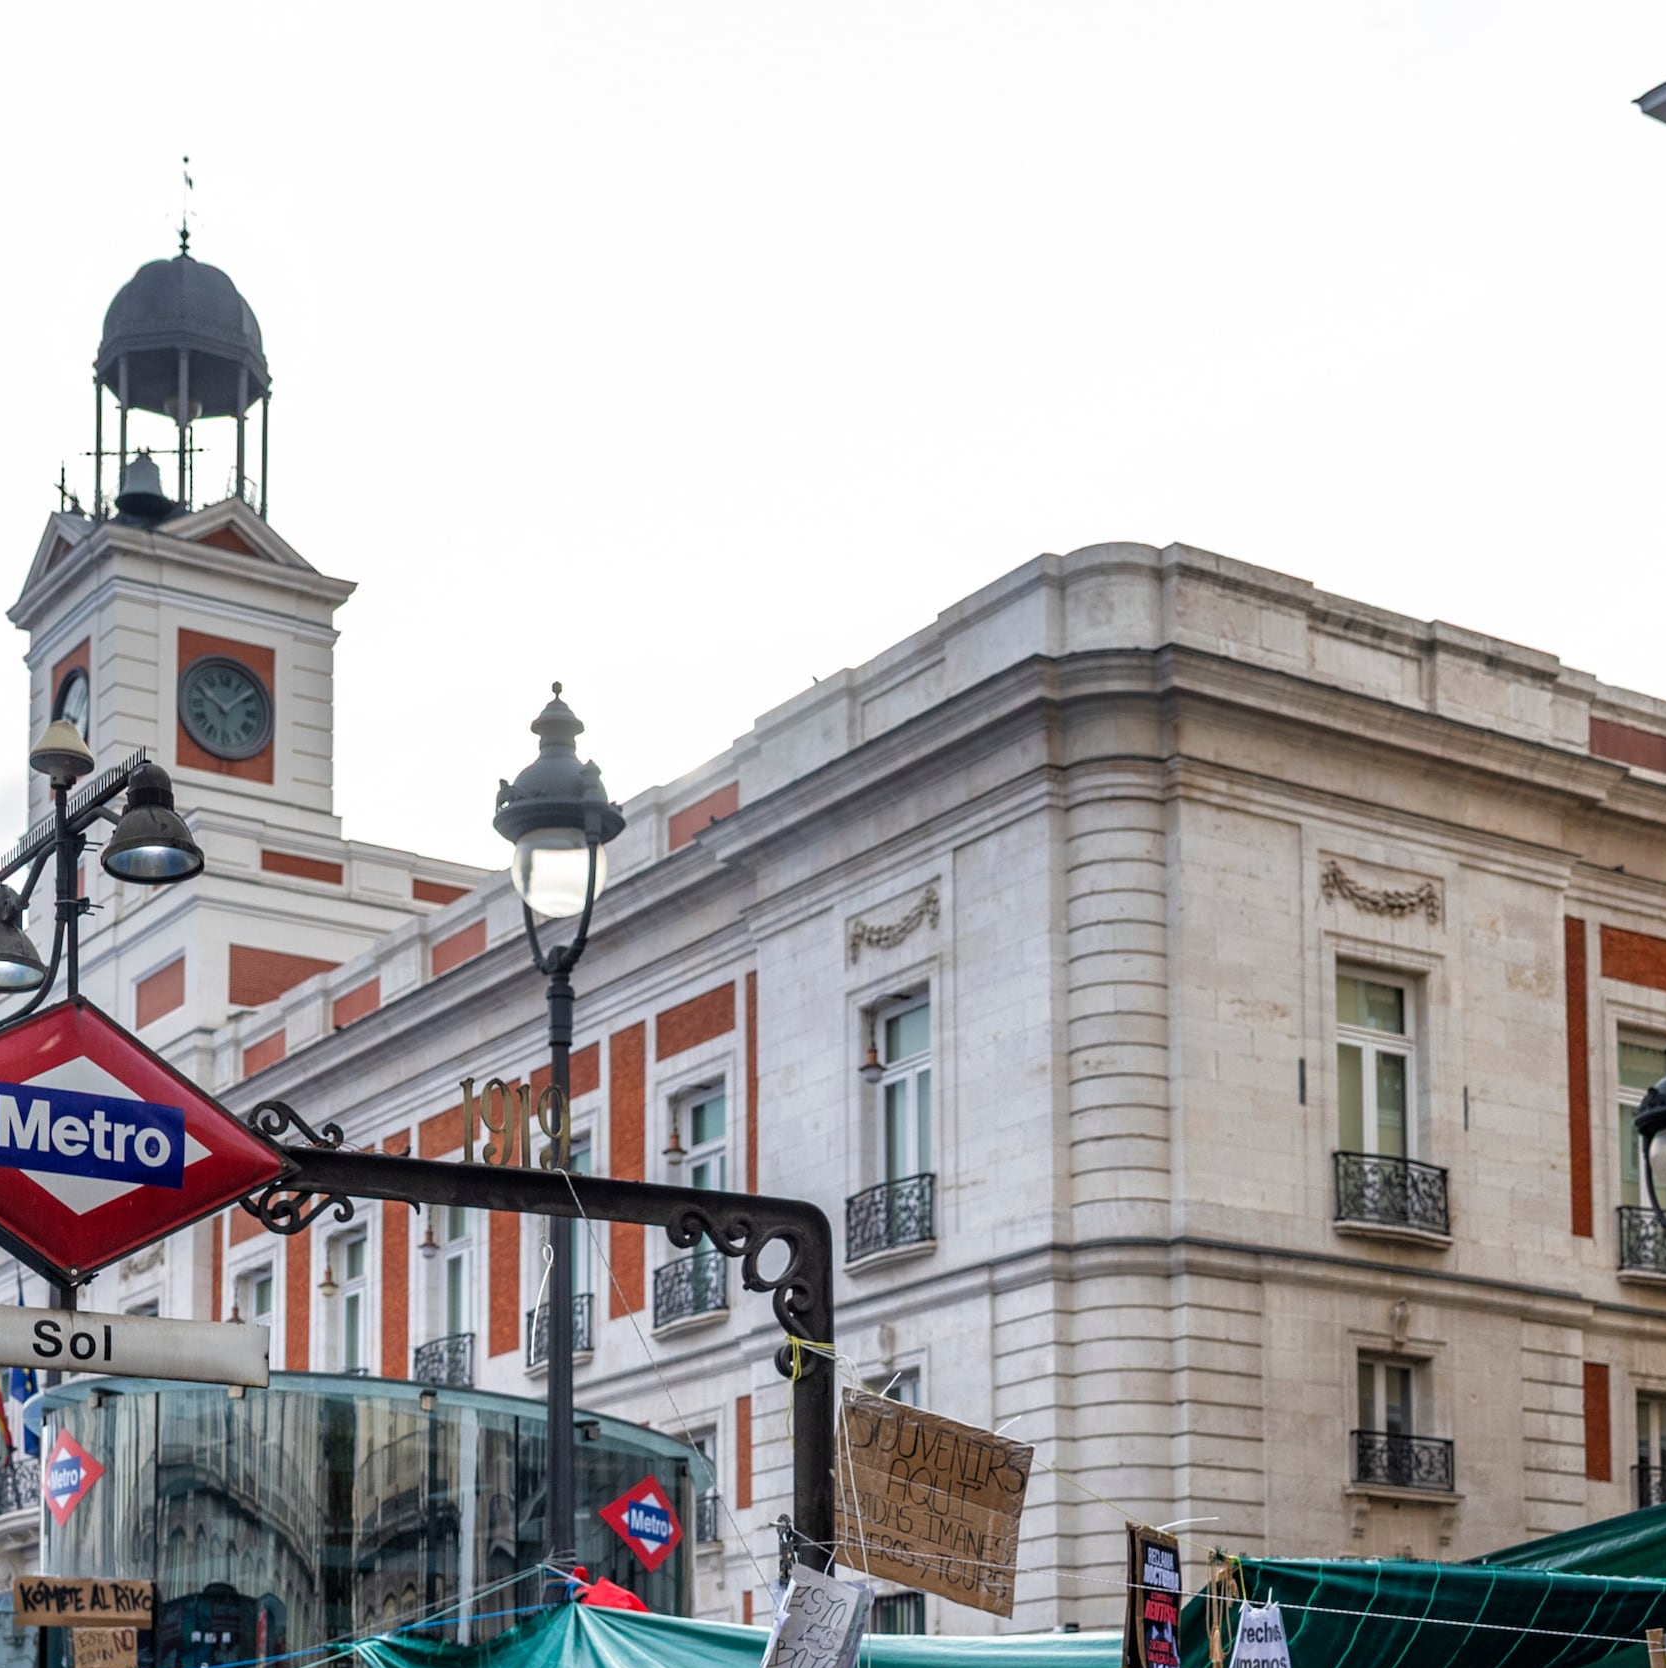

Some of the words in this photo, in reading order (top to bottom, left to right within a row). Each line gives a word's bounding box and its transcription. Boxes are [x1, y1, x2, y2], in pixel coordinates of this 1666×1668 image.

[33, 1321, 112, 1361] Sol
[49, 1463, 80, 1492] Metro
[629, 1506, 668, 1538] Metro
[90, 1583, 111, 1610] AL
[112, 1629, 134, 1653] NO
